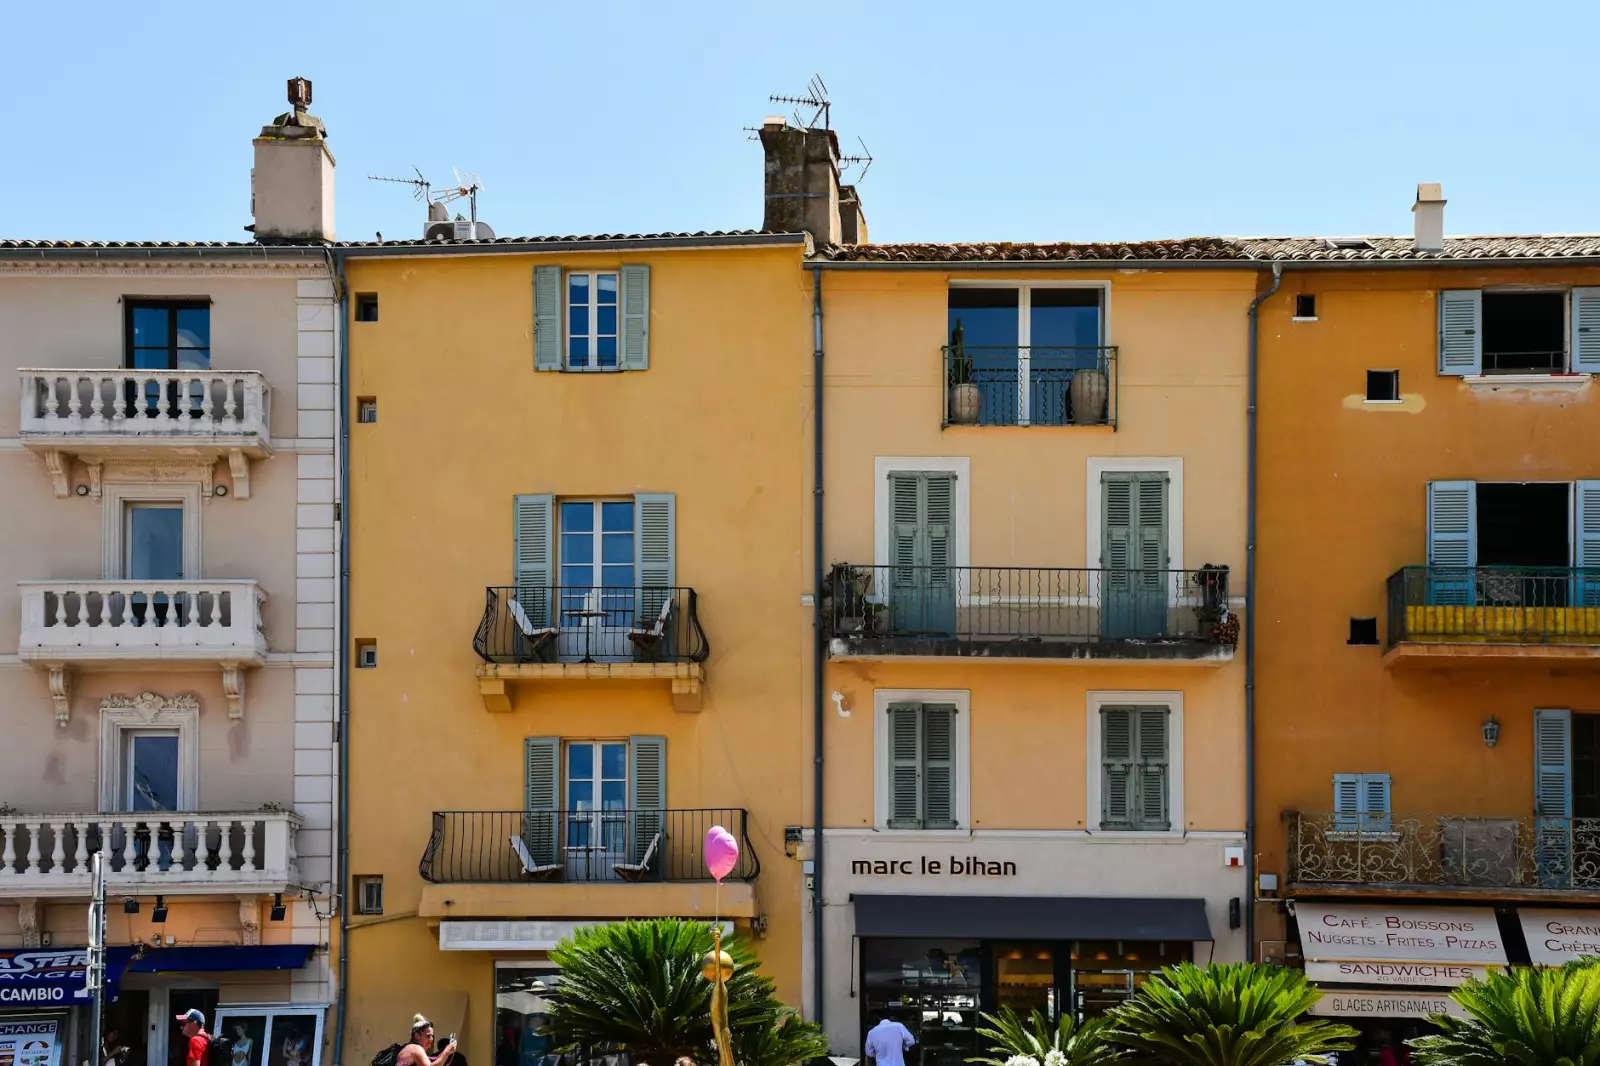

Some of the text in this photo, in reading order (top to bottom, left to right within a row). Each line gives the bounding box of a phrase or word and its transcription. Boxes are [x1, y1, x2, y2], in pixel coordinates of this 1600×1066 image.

[852, 855, 1017, 876] marc le bihan
[1385, 916, 1475, 932] BOISSONS
[1546, 921, 1600, 936] GRAN
[1308, 930, 1498, 949] NUGGETS FRITES PIZZAS
[1339, 963, 1474, 979] SANDWICHES
[0, 987, 64, 1001] CAMBIO
[1332, 998, 1447, 1013] GLACES ARTISANALES
